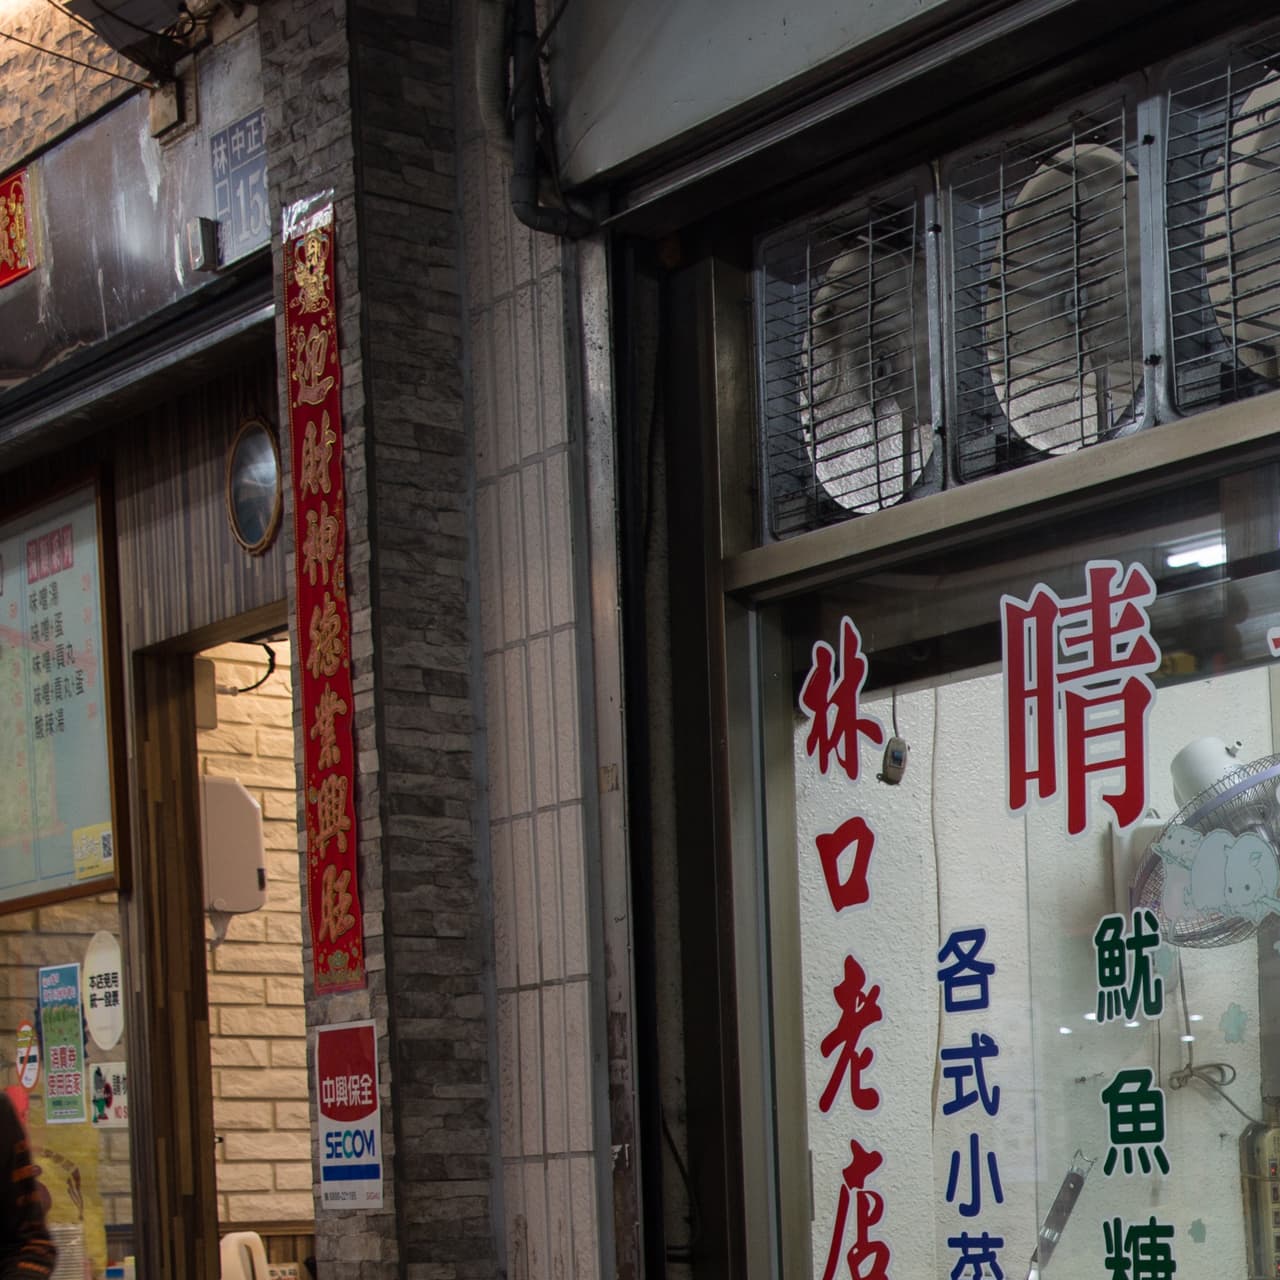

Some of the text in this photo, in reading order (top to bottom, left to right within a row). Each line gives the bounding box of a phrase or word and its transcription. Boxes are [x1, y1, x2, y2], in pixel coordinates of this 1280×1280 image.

[231, 113, 267, 160] 中正
[322, 1073, 373, 1108] 中興保全
[325, 1129, 375, 1159] SECOM
